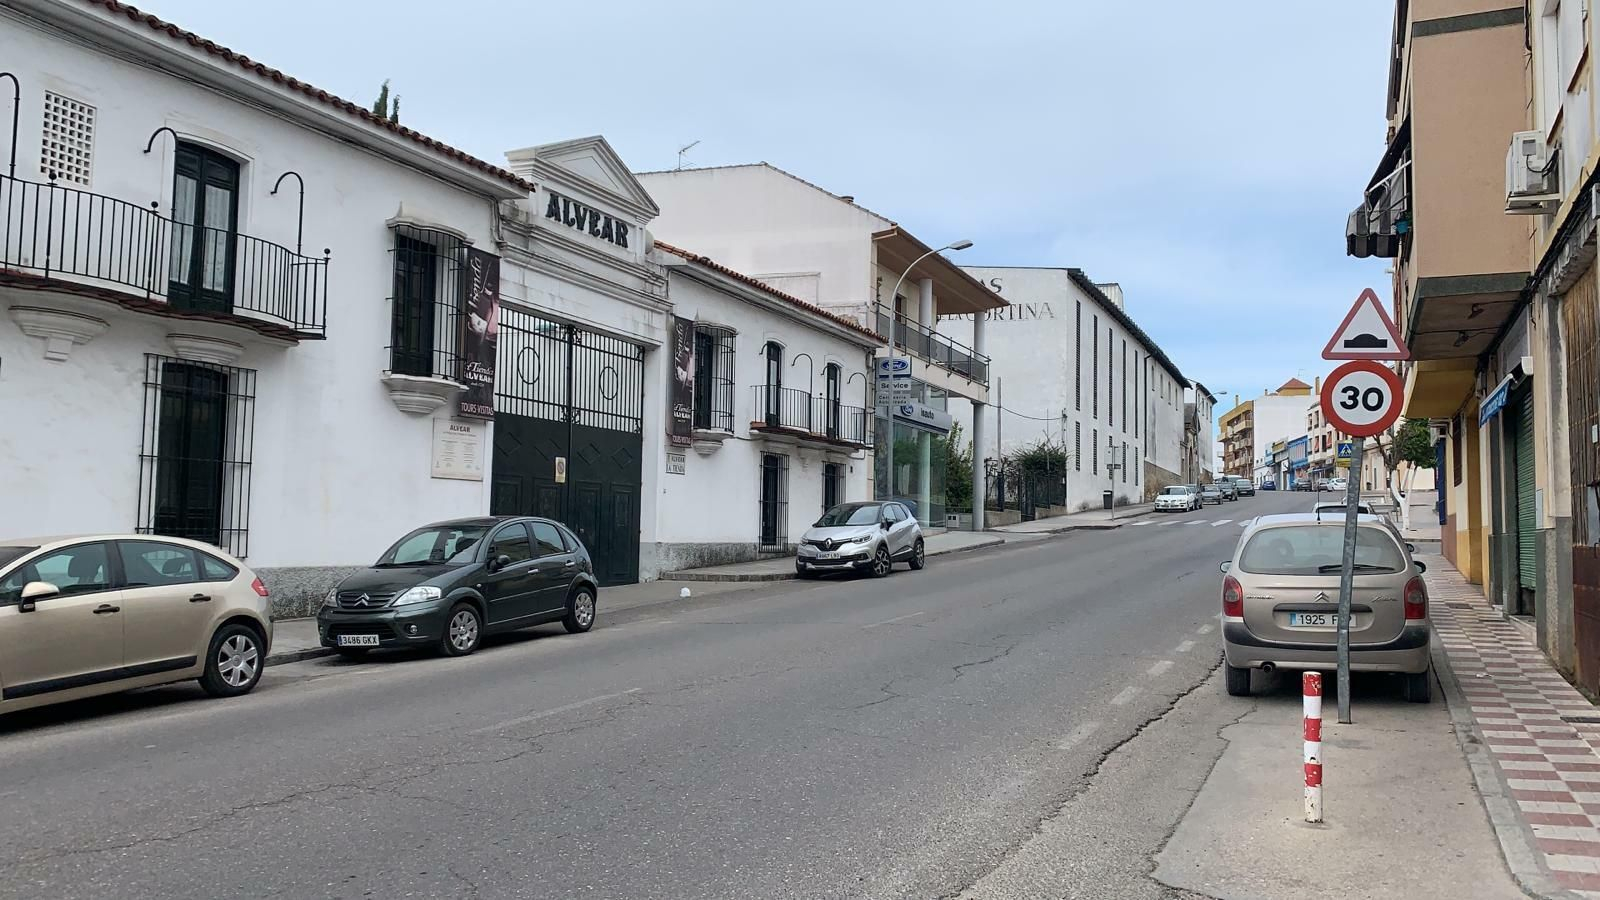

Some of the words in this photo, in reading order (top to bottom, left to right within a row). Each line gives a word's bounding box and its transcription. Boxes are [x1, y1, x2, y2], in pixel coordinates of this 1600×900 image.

[545, 193, 629, 249] ALVEAR
[1340, 386, 1384, 412] 30
[1299, 615, 1326, 625] 1925
[362, 636, 377, 645] GKX
